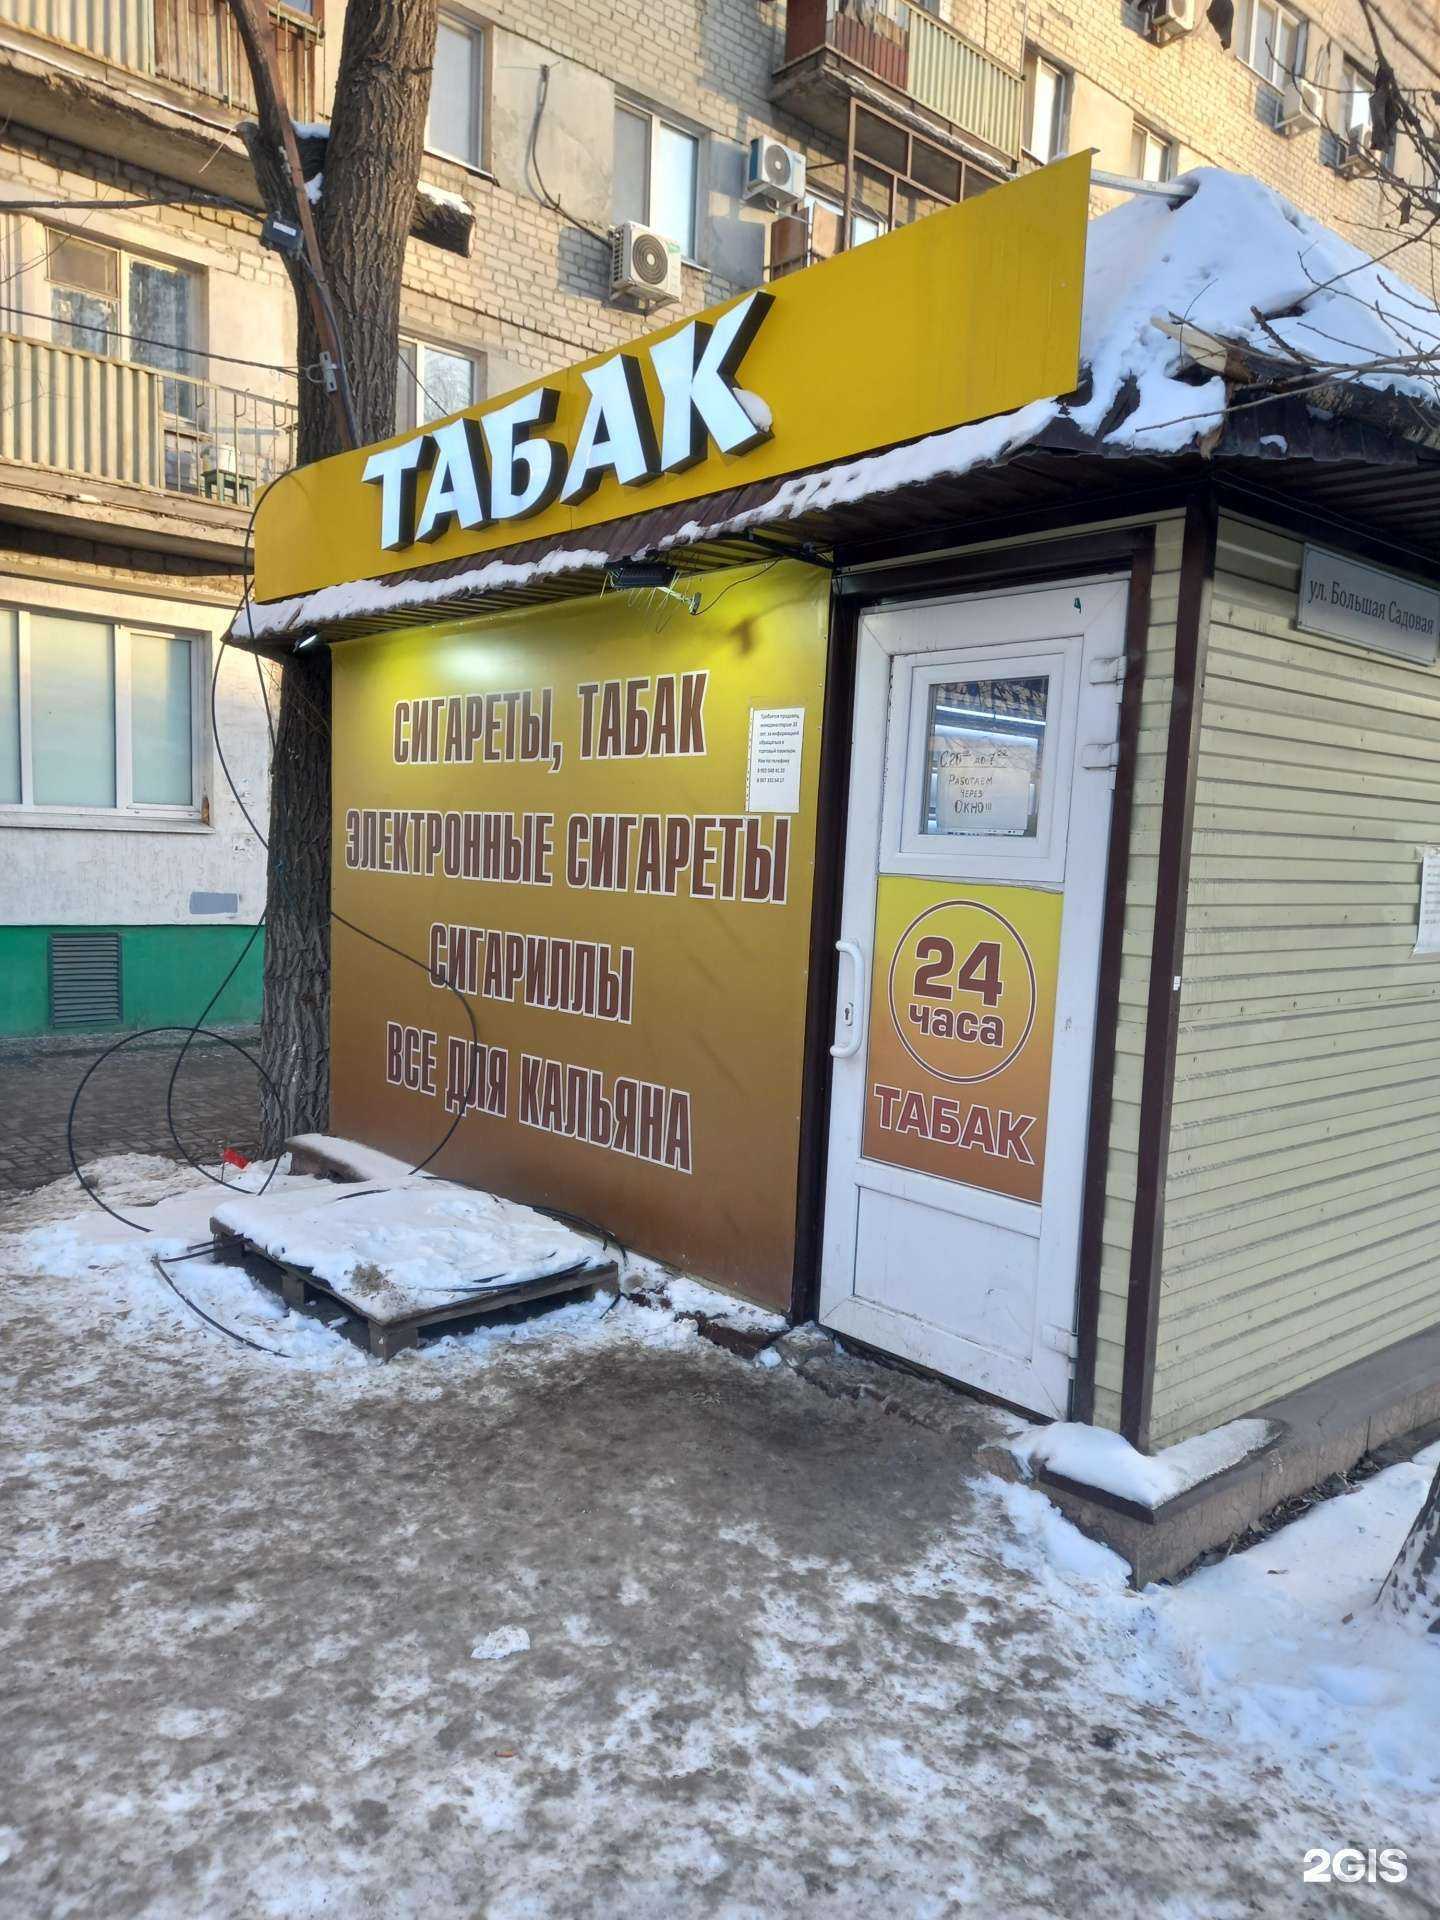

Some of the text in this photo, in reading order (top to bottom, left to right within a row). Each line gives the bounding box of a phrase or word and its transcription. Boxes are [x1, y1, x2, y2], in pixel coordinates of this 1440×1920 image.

[362, 290, 774, 553] ТАБАК
[1307, 580, 1435, 635] ул. Большая Садовая
[393, 669, 710, 774] СИГАРЕТЫ, ТАБАК
[345, 808, 791, 905] ЭЛЕКТРОННЫЕ СИГАРЕТЫ
[428, 922, 635, 1025] СИГАРИЛЛЫ
[912, 935, 1004, 1008] 24
[908, 1002, 1005, 1048] часа
[386, 1020, 692, 1175] ВСЕ ДЛЯ КАЛЬЯНА
[873, 1083, 1037, 1166] ТАБАК
